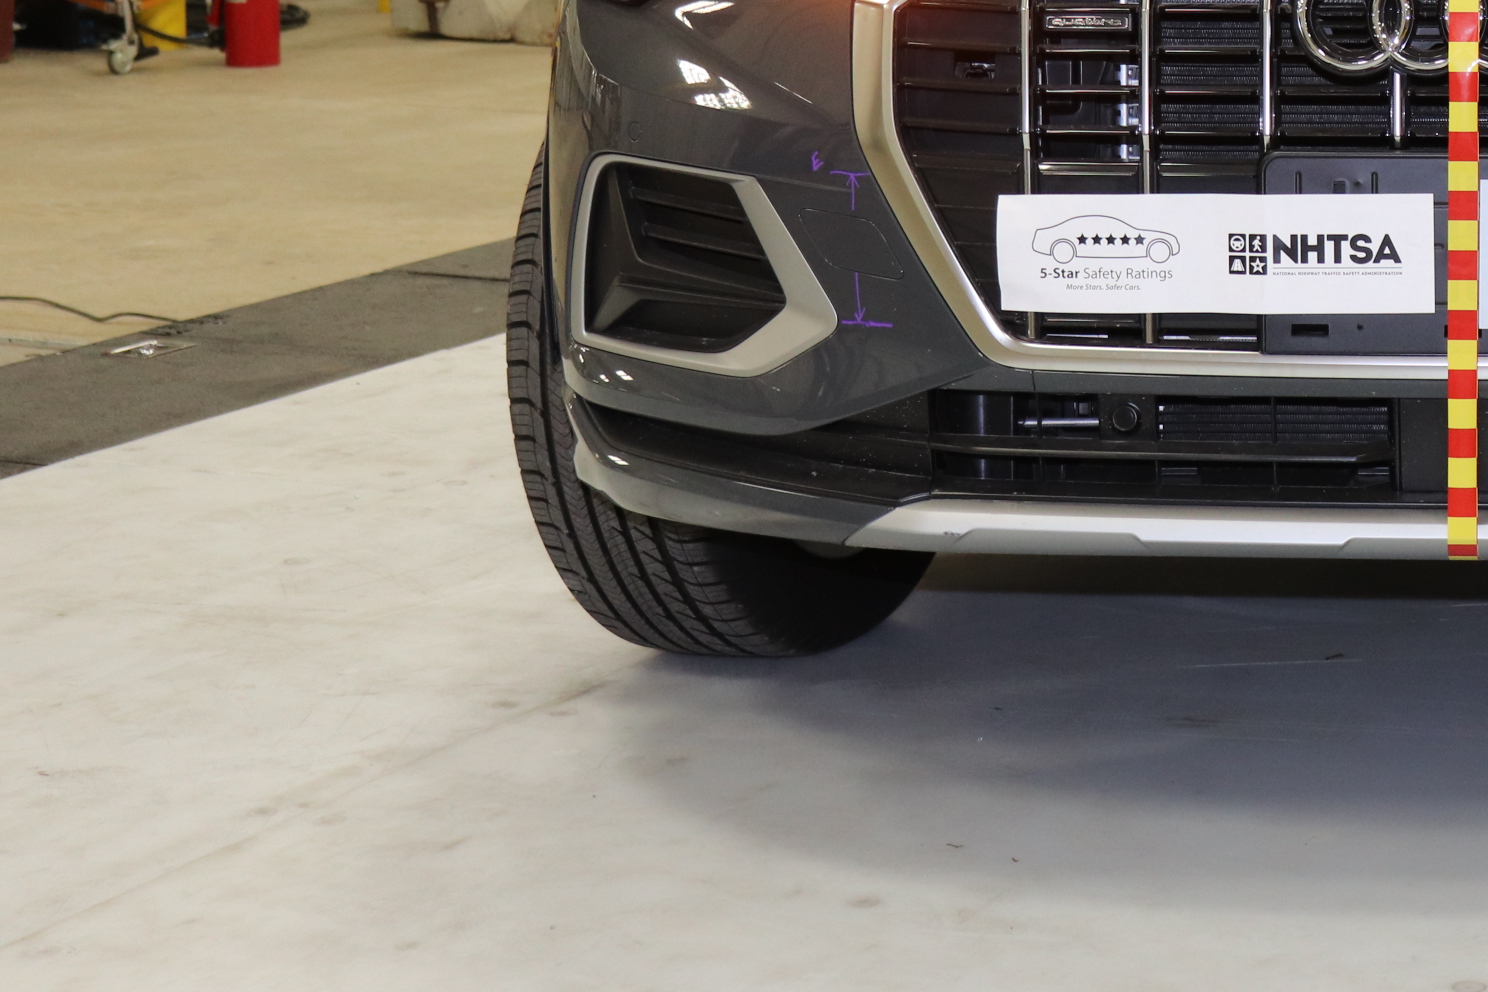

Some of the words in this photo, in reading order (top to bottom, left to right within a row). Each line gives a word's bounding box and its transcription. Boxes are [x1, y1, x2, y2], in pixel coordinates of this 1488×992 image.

[1272, 233, 1403, 265] NHTSA
[1040, 267, 1080, 279] 5-Star
[1083, 267, 1122, 282] Safety
[1126, 267, 1173, 282] Ratings
[1065, 283, 1084, 291] More
[1084, 283, 1104, 291] Stars.
[1105, 283, 1123, 291] Safer
[1124, 283, 1142, 291] Cars.
